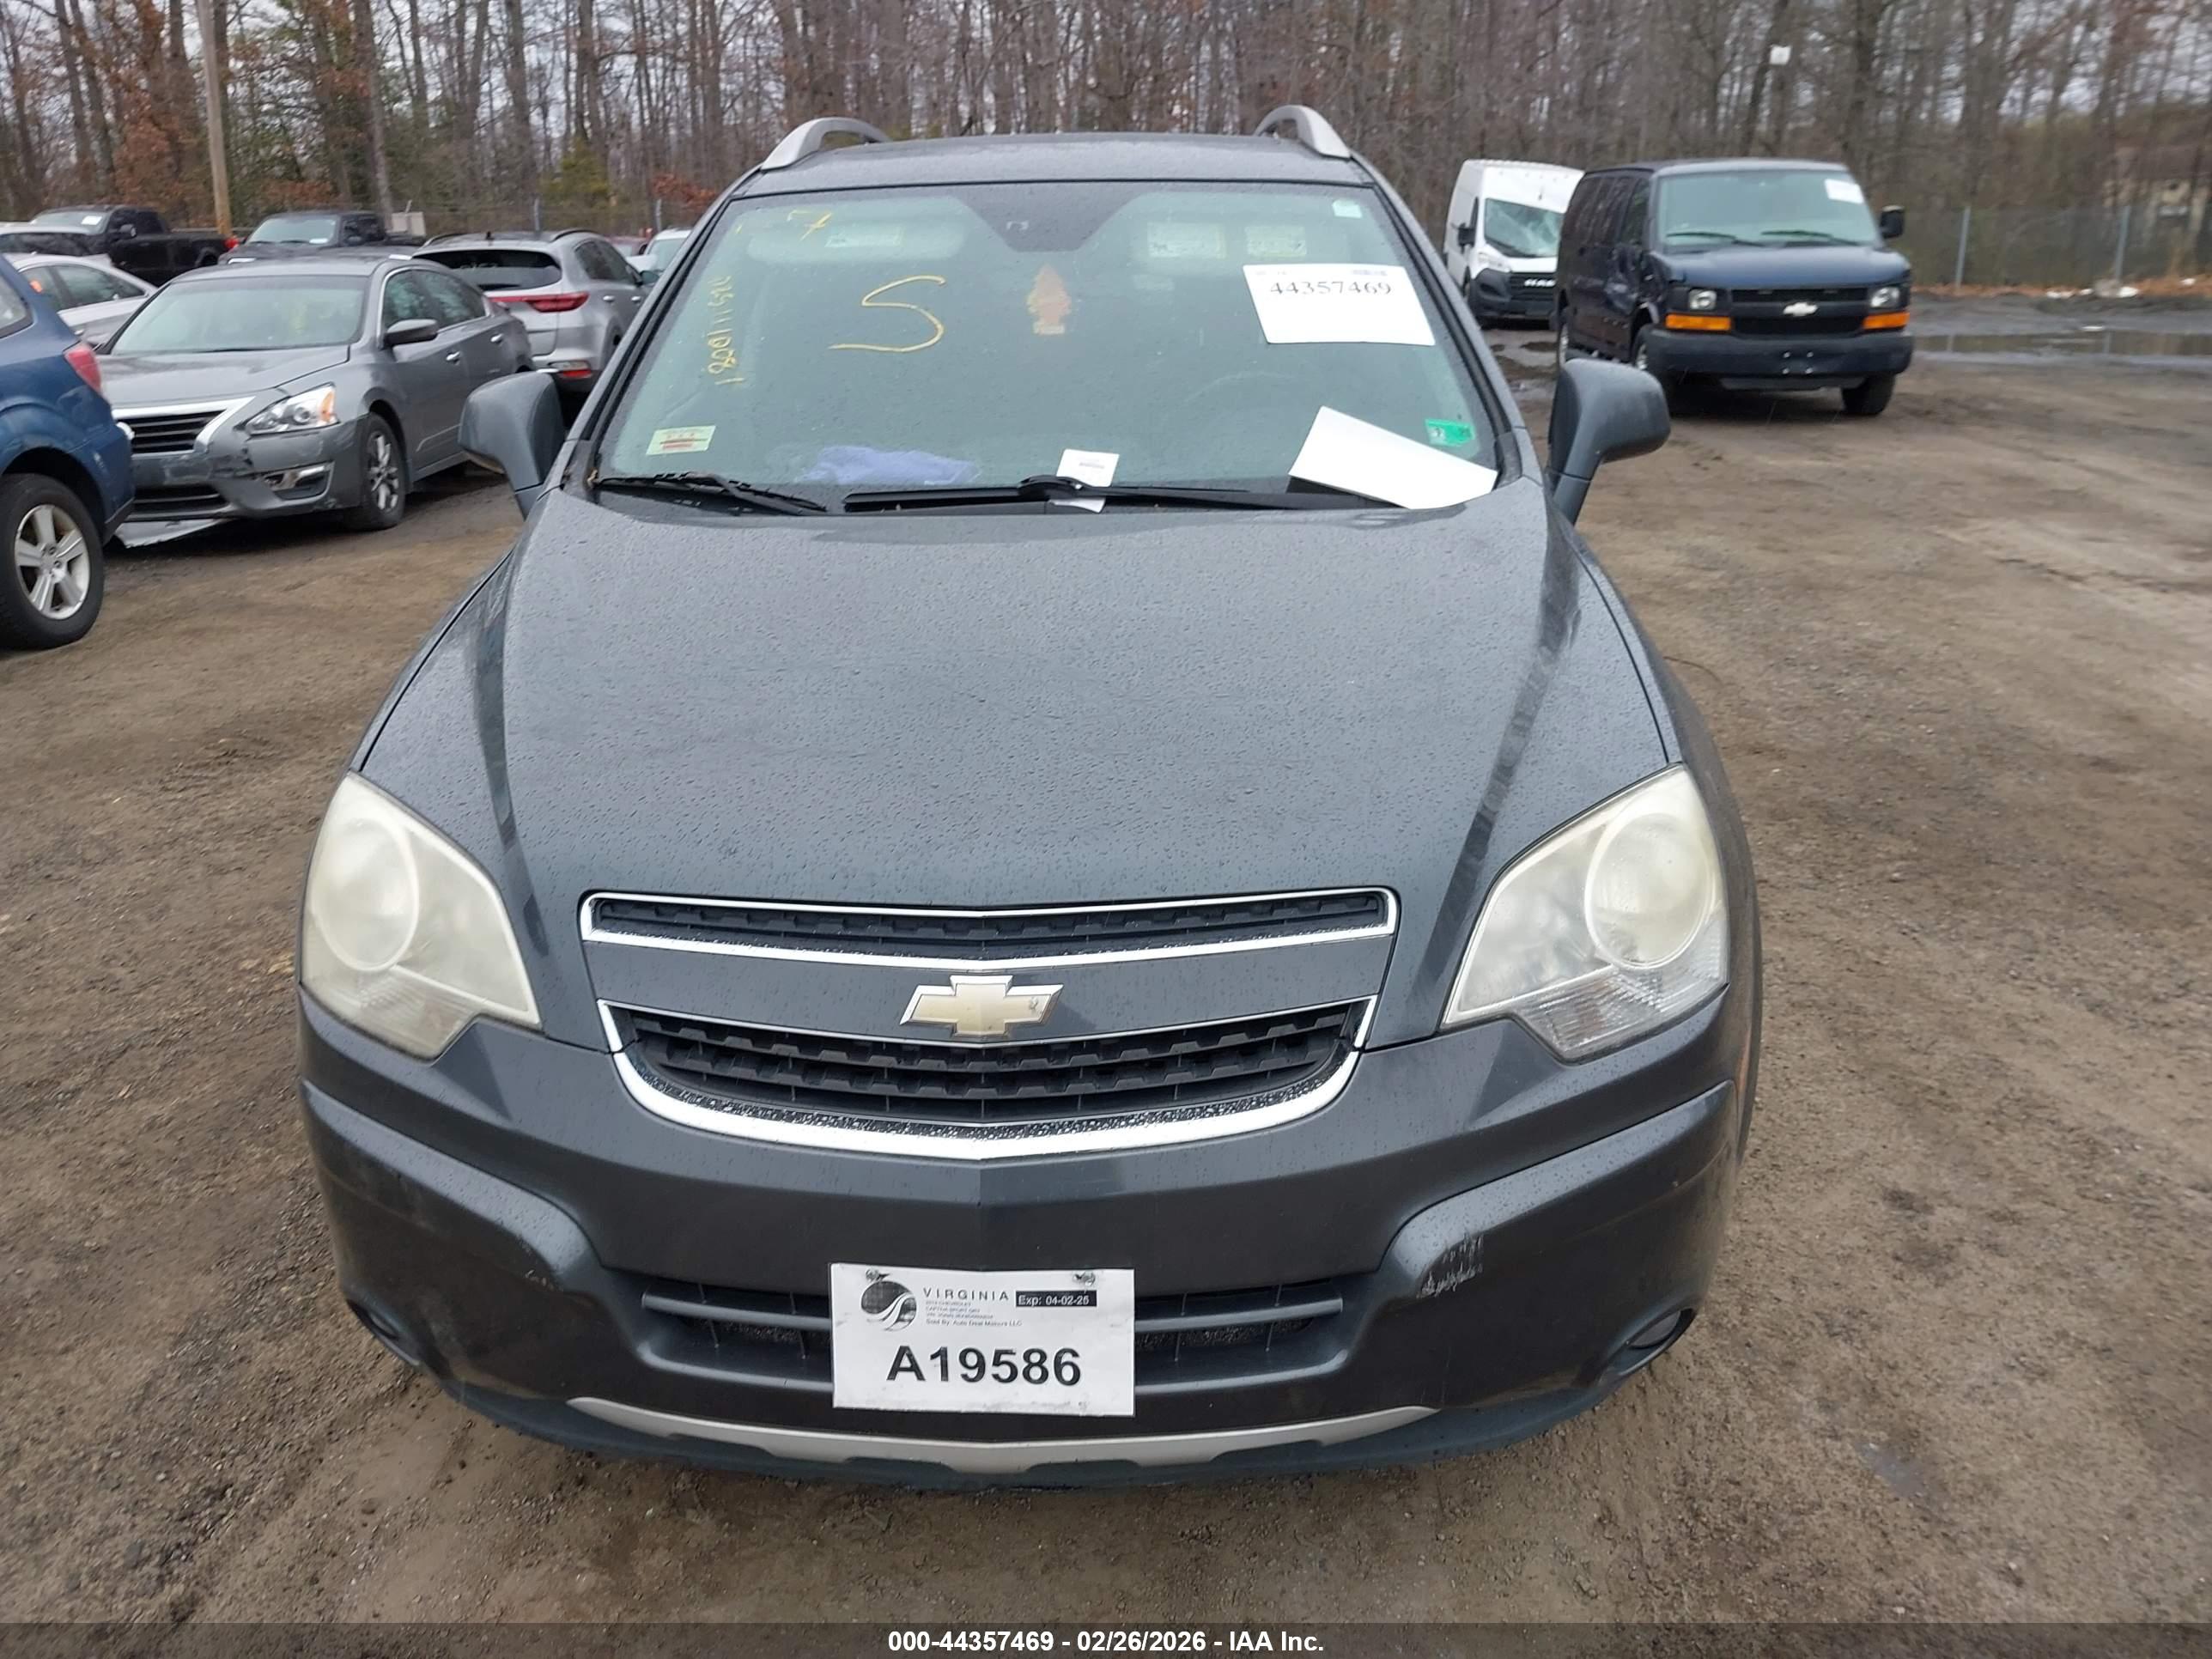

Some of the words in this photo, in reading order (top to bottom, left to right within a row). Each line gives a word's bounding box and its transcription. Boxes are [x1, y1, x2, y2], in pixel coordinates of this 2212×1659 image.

[1270, 280, 1392, 295] 44357469
[923, 1287, 1009, 1301] VIRGINIA
[1018, 1294, 1042, 1308] Exp:
[885, 1345, 1082, 1386] A19586
